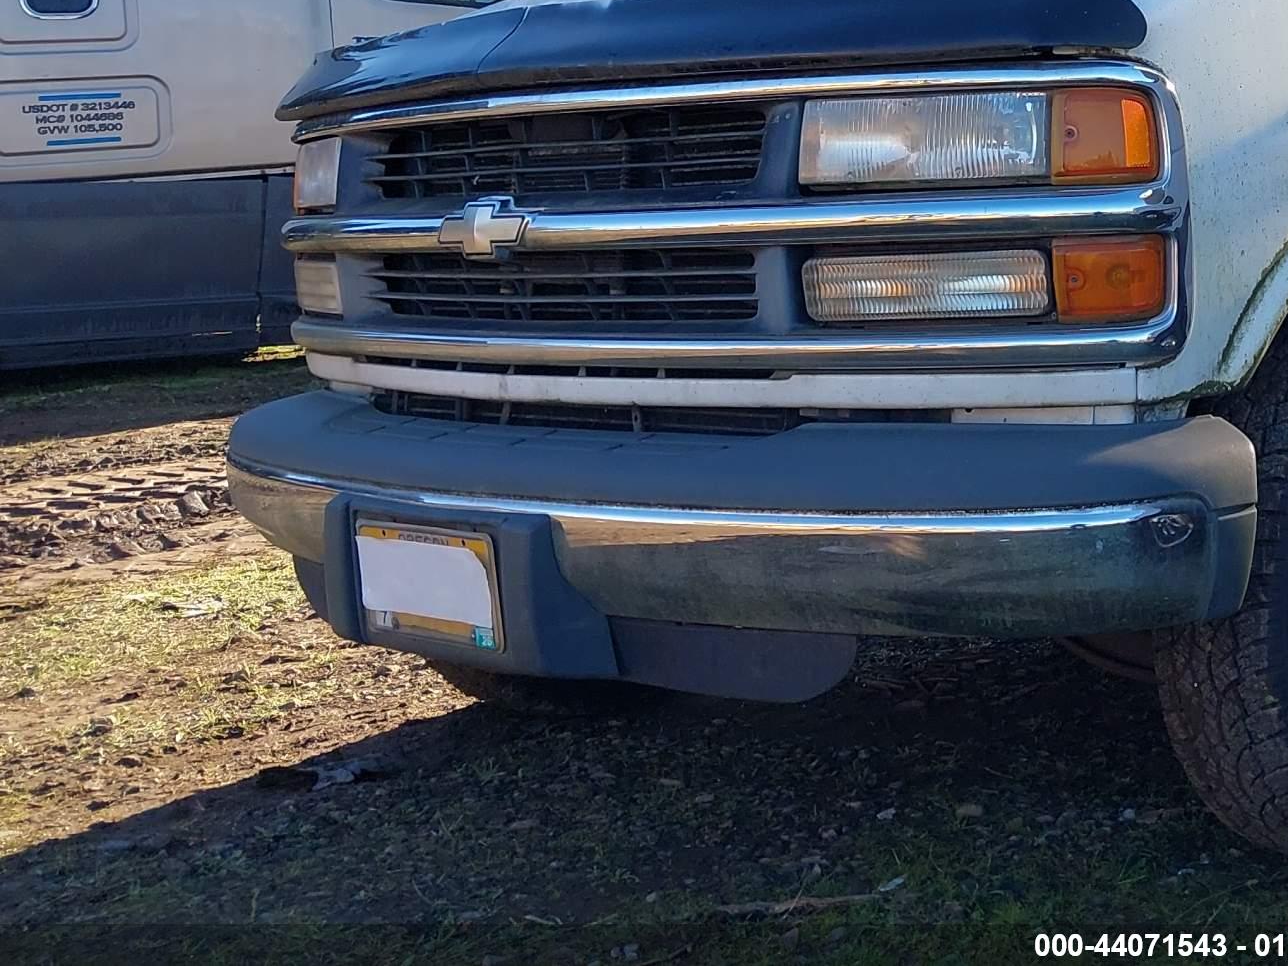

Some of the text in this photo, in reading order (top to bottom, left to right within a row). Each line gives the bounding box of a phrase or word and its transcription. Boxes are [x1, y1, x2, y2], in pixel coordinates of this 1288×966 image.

[22, 103, 68, 114] USDOT
[37, 122, 123, 135] GVW 105,500
